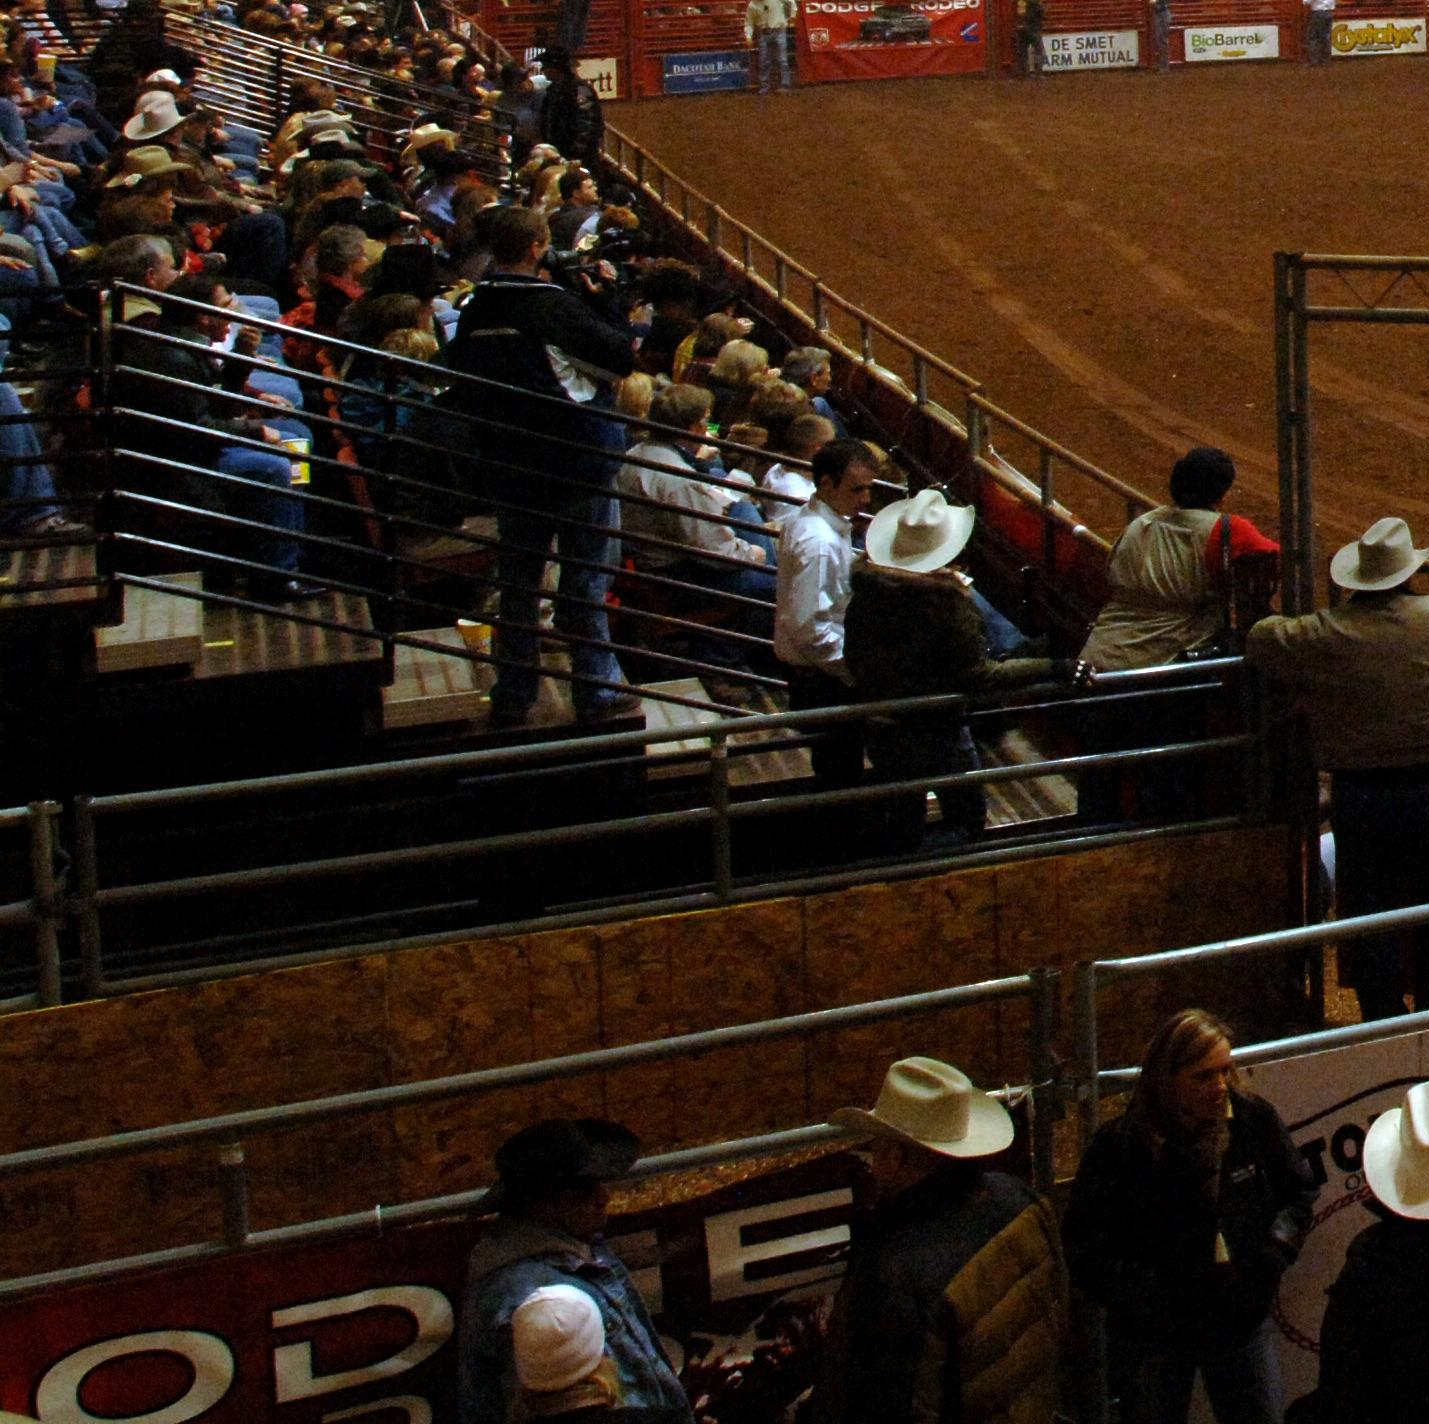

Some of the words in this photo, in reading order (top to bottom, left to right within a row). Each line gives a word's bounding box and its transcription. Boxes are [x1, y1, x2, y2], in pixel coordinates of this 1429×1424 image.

[1052, 38, 1069, 51] DE
[1076, 35, 1114, 50] SMET
[1191, 32, 1263, 46] BioBarrel
[1078, 50, 1134, 65] MUTUAL
